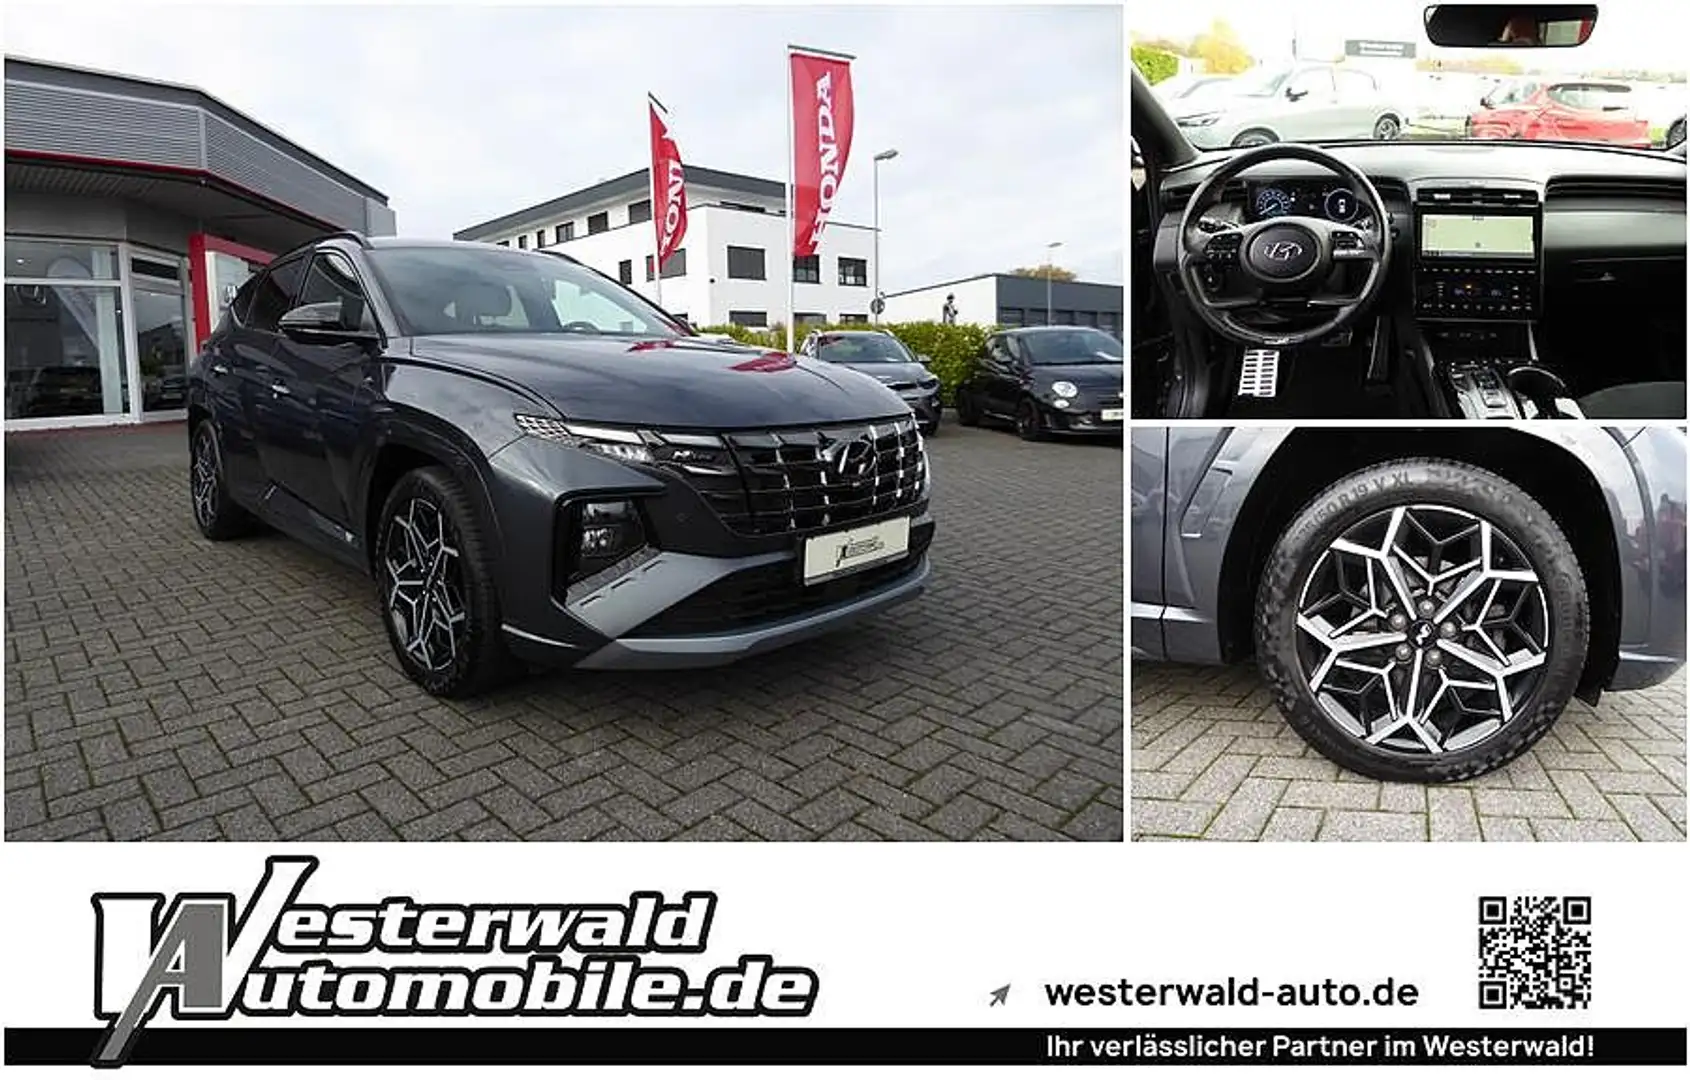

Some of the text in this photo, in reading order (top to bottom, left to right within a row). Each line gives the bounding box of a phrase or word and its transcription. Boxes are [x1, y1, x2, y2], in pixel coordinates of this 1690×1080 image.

[809, 71, 839, 255] HONDA
[1352, 483, 1369, 500] 19
[1392, 470, 1413, 487] XL
